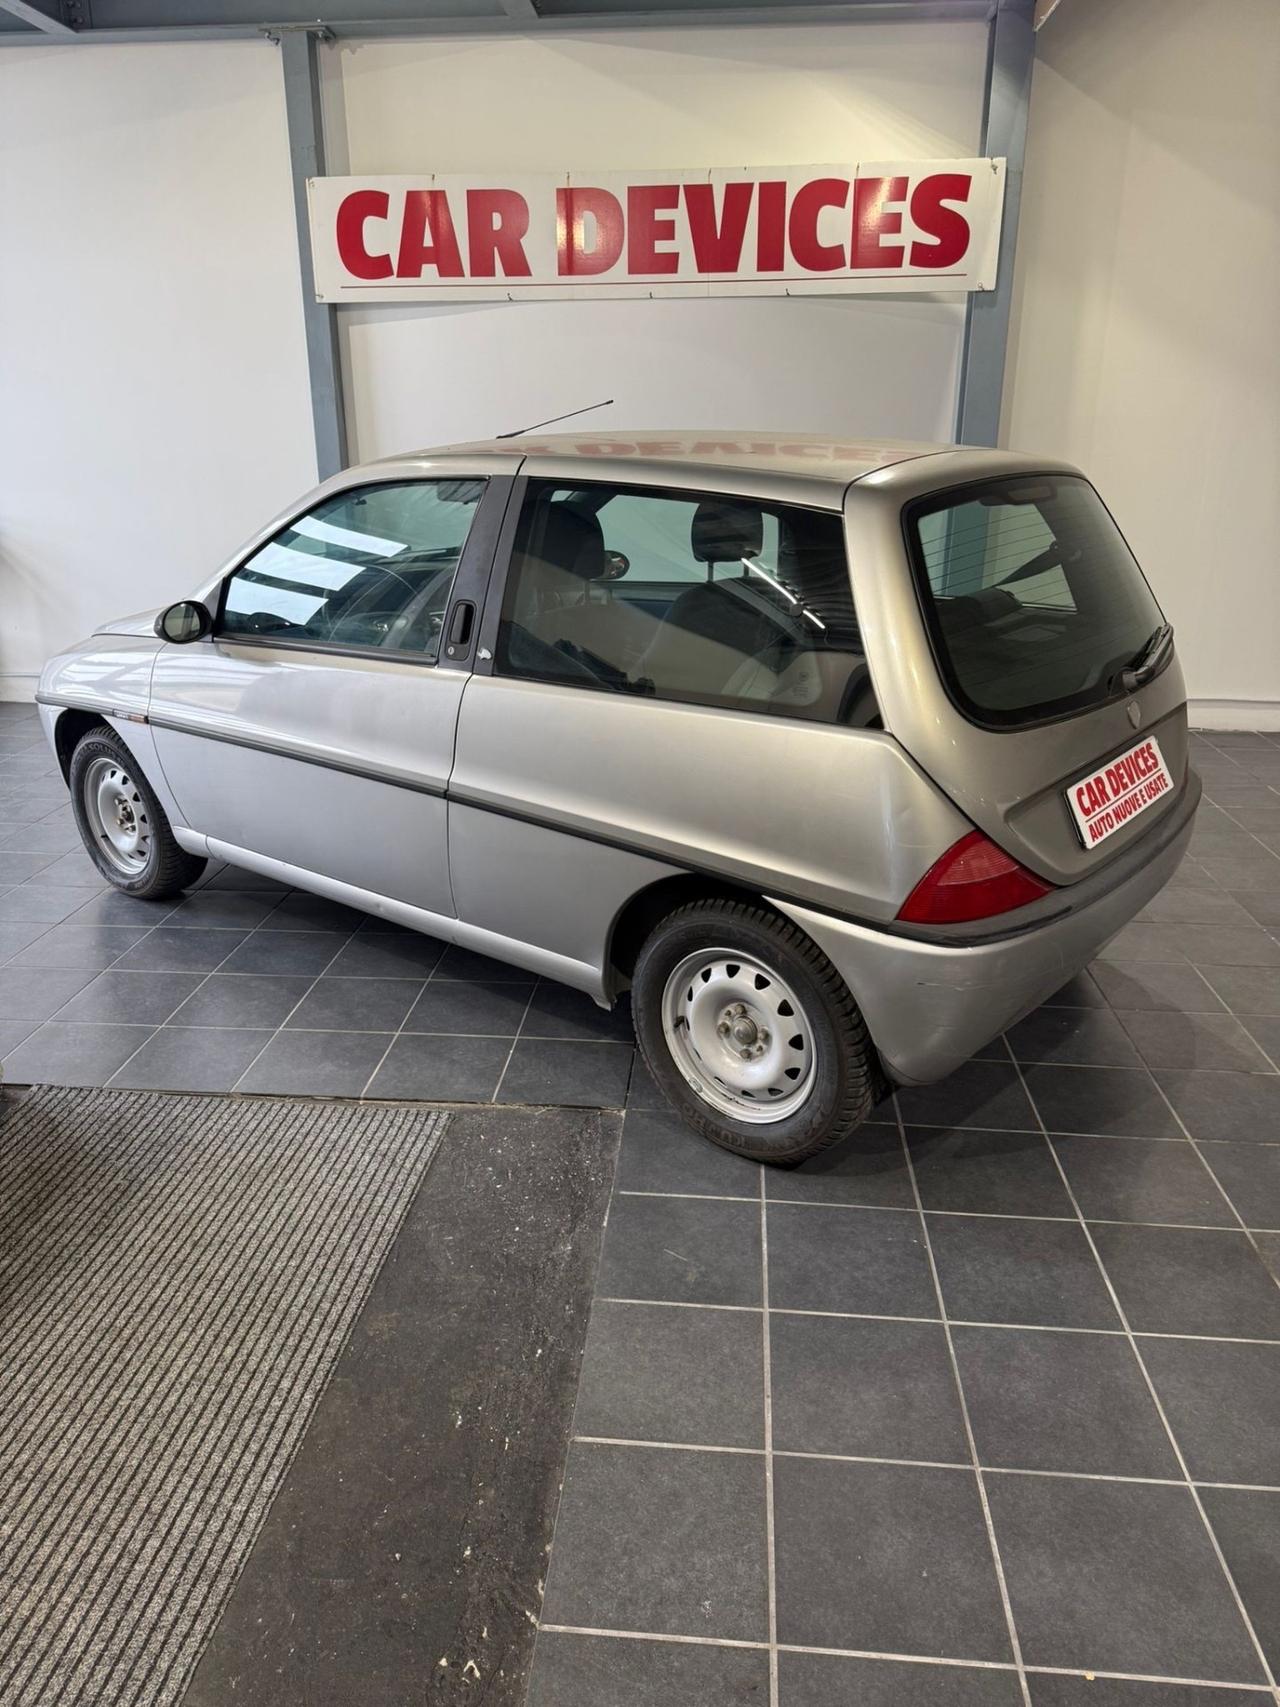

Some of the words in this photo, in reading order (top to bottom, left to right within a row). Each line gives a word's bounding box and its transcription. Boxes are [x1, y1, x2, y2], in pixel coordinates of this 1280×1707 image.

[336, 189, 532, 280] CAR
[556, 173, 972, 277] DEVICES
[1076, 775, 1111, 817] CAR
[1104, 742, 1159, 798] DEVICES
[1088, 814, 1114, 842] AUTO
[1112, 793, 1142, 825] NUOVE
[1140, 791, 1147, 804] E
[1145, 773, 1169, 800] USATE
